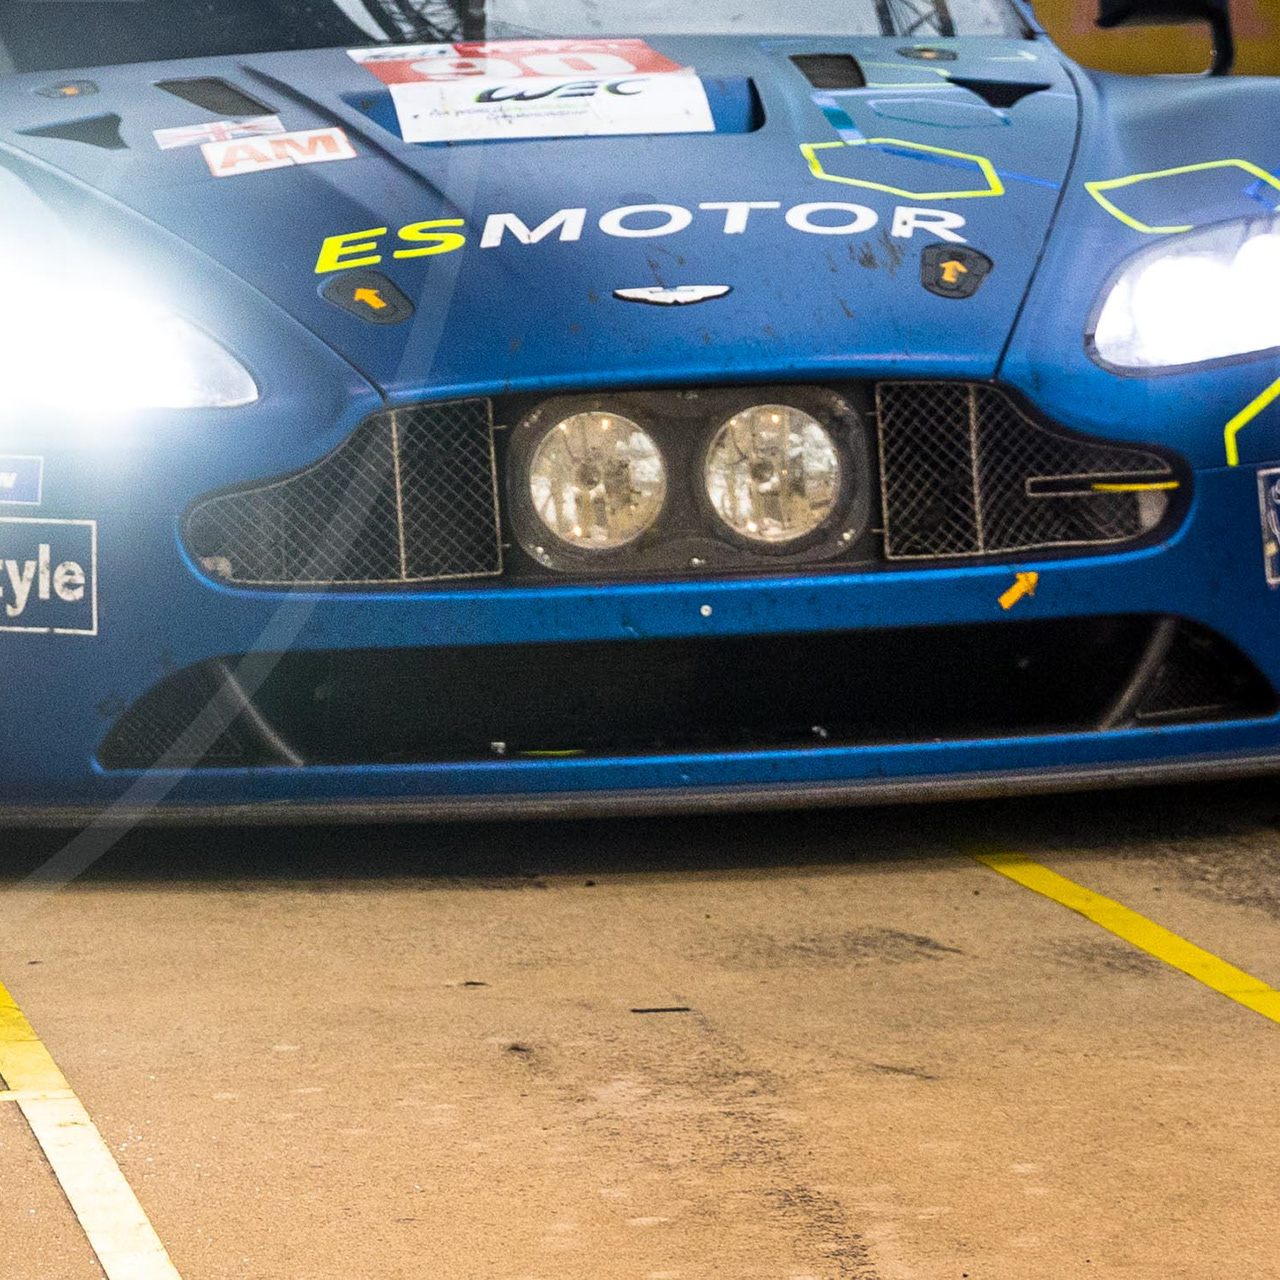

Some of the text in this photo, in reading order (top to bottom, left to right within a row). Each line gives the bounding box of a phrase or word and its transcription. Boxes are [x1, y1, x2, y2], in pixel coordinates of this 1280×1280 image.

[408, 52, 639, 81] 90
[474, 77, 650, 104] WEC
[217, 130, 346, 169] AM
